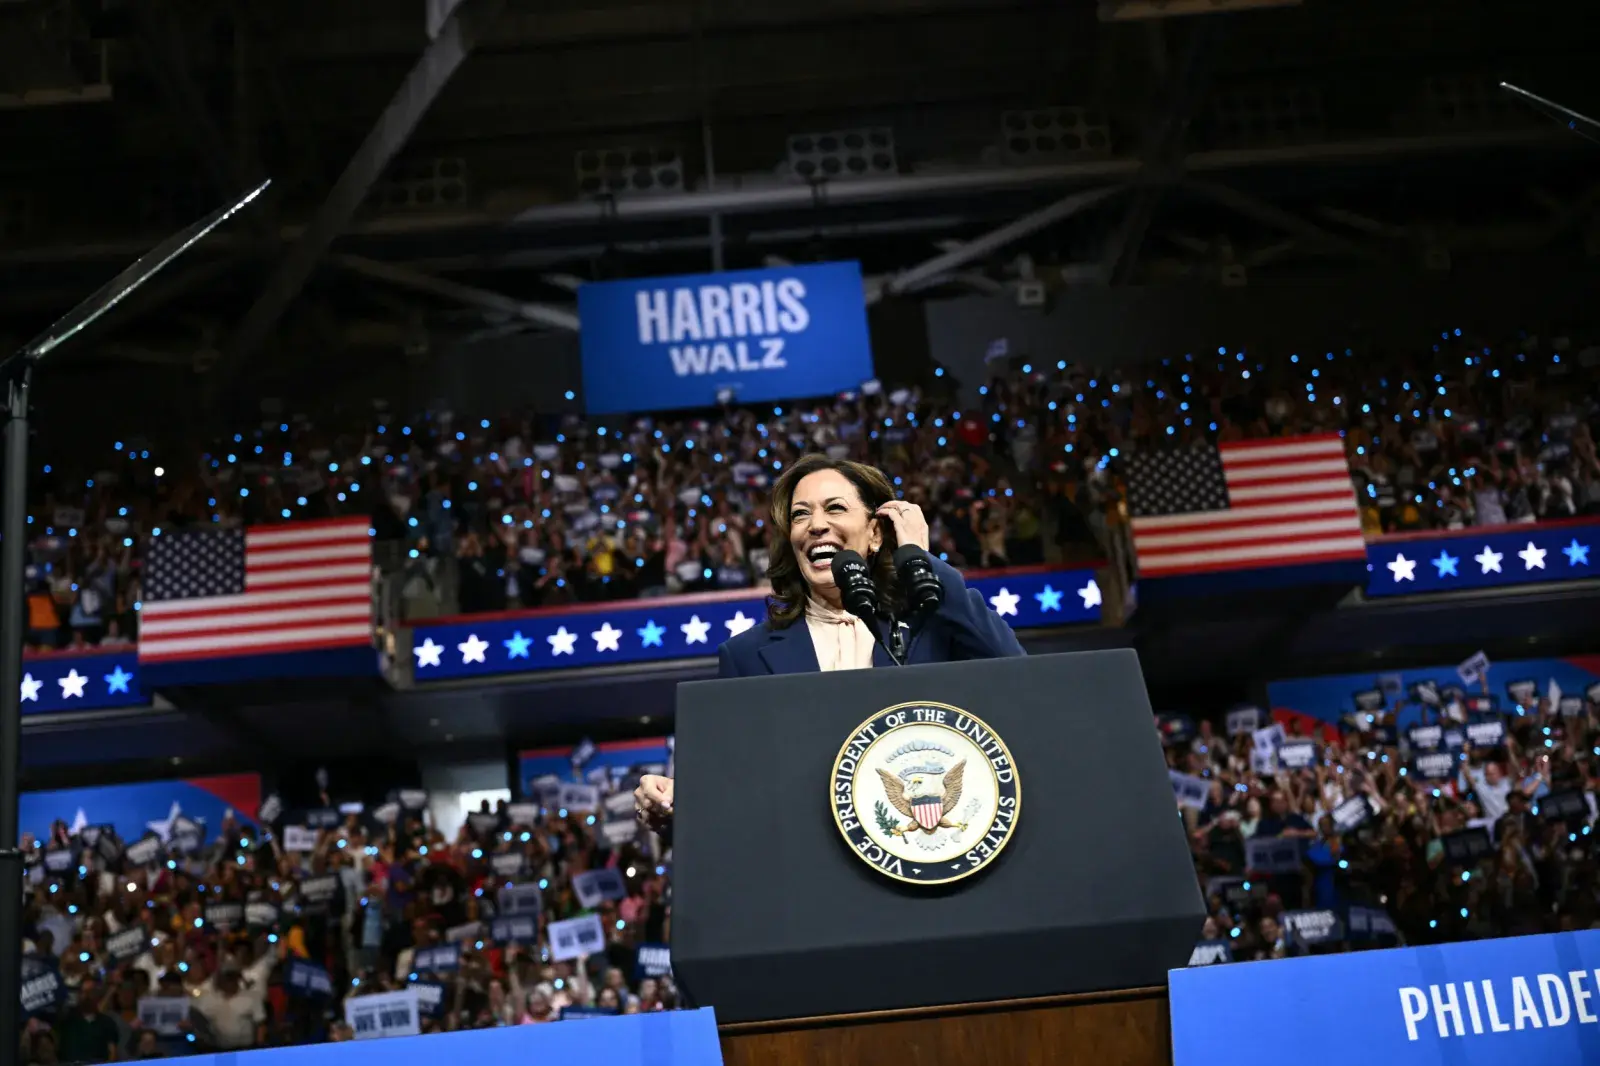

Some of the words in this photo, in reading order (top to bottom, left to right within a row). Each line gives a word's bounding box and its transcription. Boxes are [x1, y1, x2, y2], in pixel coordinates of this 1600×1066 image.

[635, 277, 810, 345] HARRIS
[669, 337, 788, 377] WALZ
[885, 711, 907, 728] OF
[913, 709, 946, 724] THE
[955, 715, 1014, 784] UNITED
[835, 723, 881, 832] PRESIDENT
[856, 837, 904, 876] VICE
[969, 796, 1017, 867] STATES
